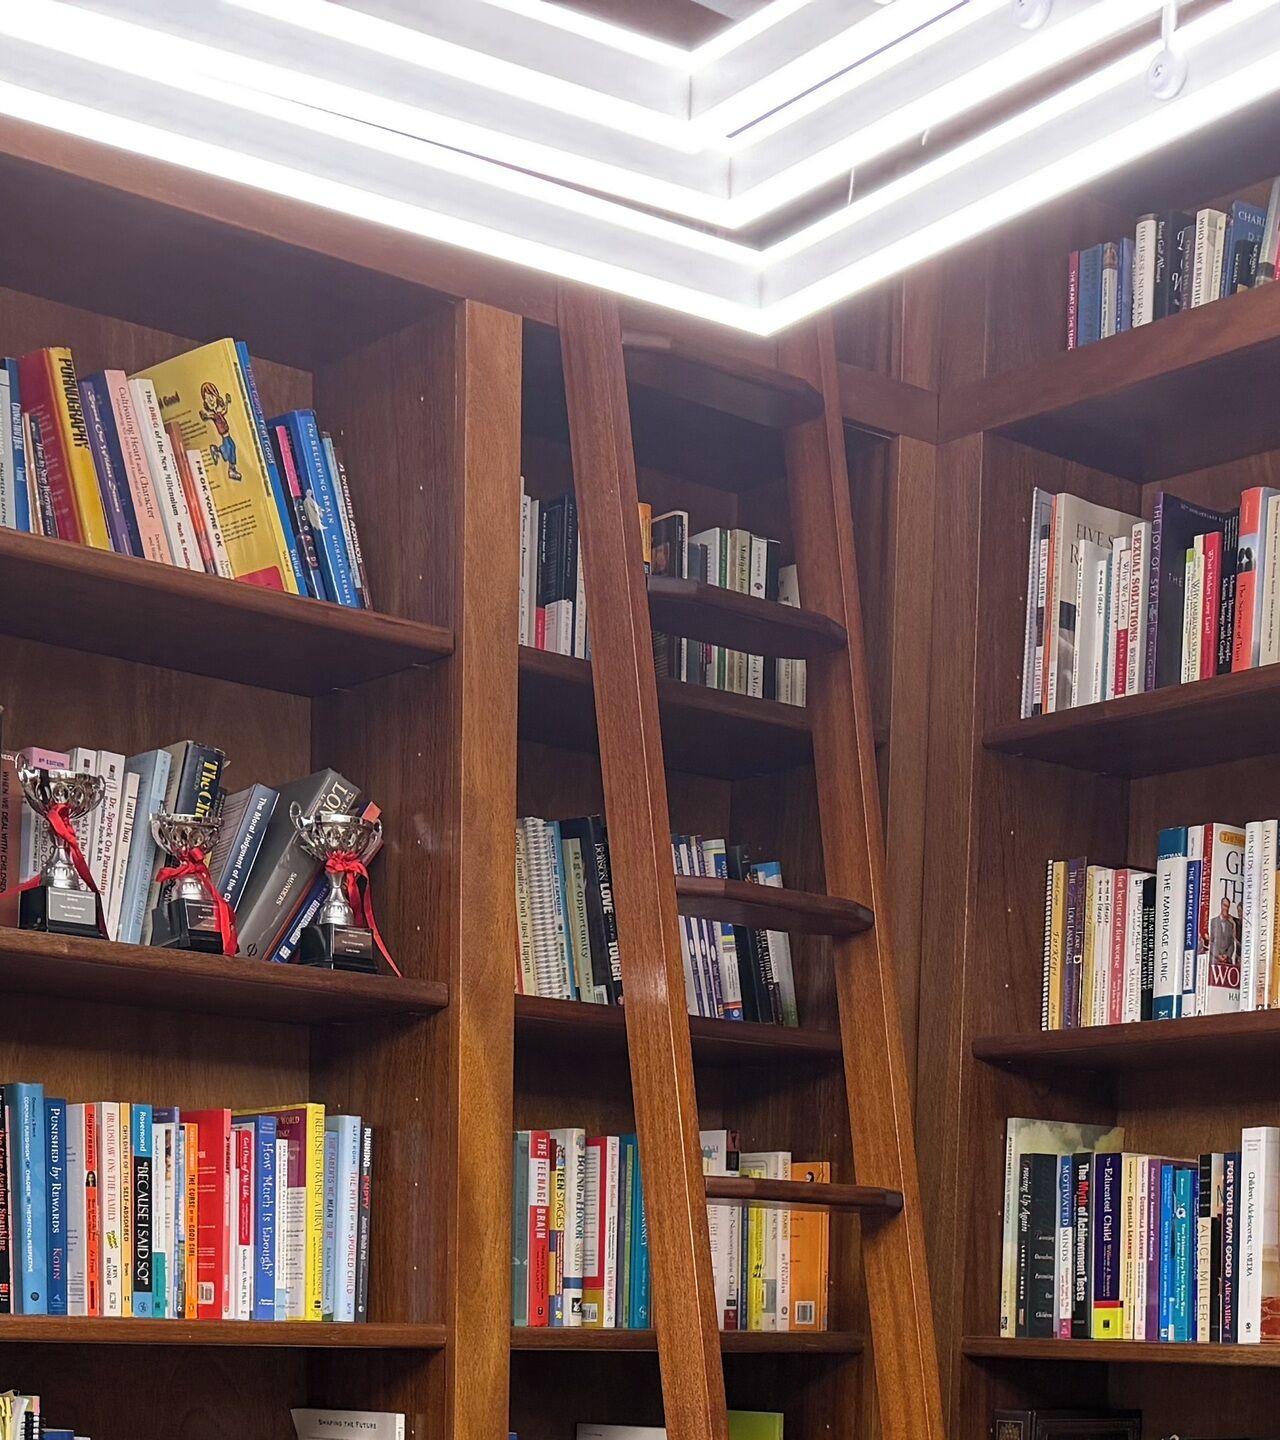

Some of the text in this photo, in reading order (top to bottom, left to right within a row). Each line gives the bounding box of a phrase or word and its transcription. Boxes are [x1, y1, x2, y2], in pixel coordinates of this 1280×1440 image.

[58, 357, 90, 450] PORNOGRAPHY
[1129, 530, 1142, 642] SEXUAL SOLUTIONS
[600, 882, 613, 914] LOVE
[1160, 872, 1171, 983] THE MARRIAGE CLINIC
[608, 940, 622, 981] TOUGH
[51, 1108, 60, 1162] PUNISHED
[50, 1166, 61, 1180] by
[536, 1138, 546, 1239] THE TEENAGE BRAIN
[1104, 1167, 1112, 1212] Educated
[52, 1183, 61, 1233] REWARDS
[261, 1141, 273, 1277] How Much Is Enough?
[1103, 1215, 1112, 1241] Child
[137, 1228, 149, 1259] SAID
[1199, 1224, 1209, 1321] ALICE MILLER
